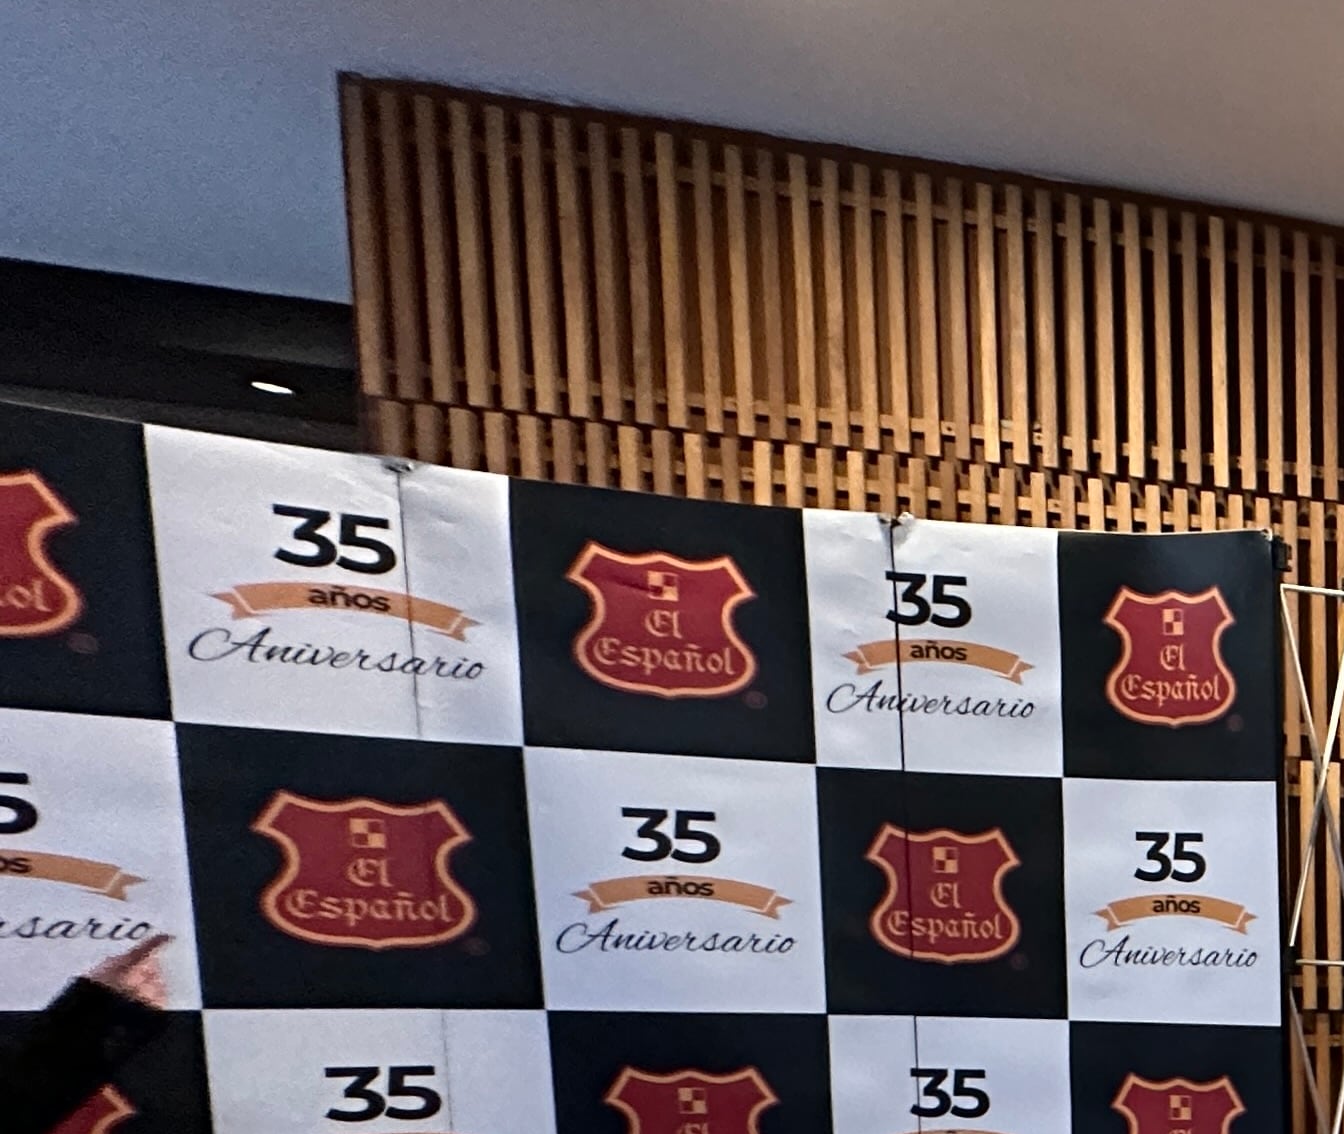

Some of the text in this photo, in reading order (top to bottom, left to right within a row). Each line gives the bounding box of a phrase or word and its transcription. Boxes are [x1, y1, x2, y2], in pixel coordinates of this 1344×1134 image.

[272, 504, 397, 575] 35
[309, 586, 391, 615] años
[885, 571, 972, 629] 35
[645, 609, 682, 639] El
[188, 628, 486, 681] Aniversario
[595, 638, 736, 676] Español
[909, 639, 968, 662] años
[1160, 645, 1185, 671] El
[826, 679, 1038, 720] Aniversario
[1121, 675, 1220, 706] Español
[0, 771, 38, 835] 5
[621, 807, 721, 864] 35
[347, 858, 393, 889] El
[1134, 831, 1207, 882] 35
[647, 877, 714, 896] años
[930, 882, 962, 910] El
[285, 888, 455, 924] Español
[1152, 896, 1201, 915] años
[556, 918, 796, 954] Aniversario
[886, 910, 1005, 941] Español
[1079, 935, 1259, 969] Aniversario
[323, 1065, 441, 1122] 35
[909, 1068, 991, 1119] 35
